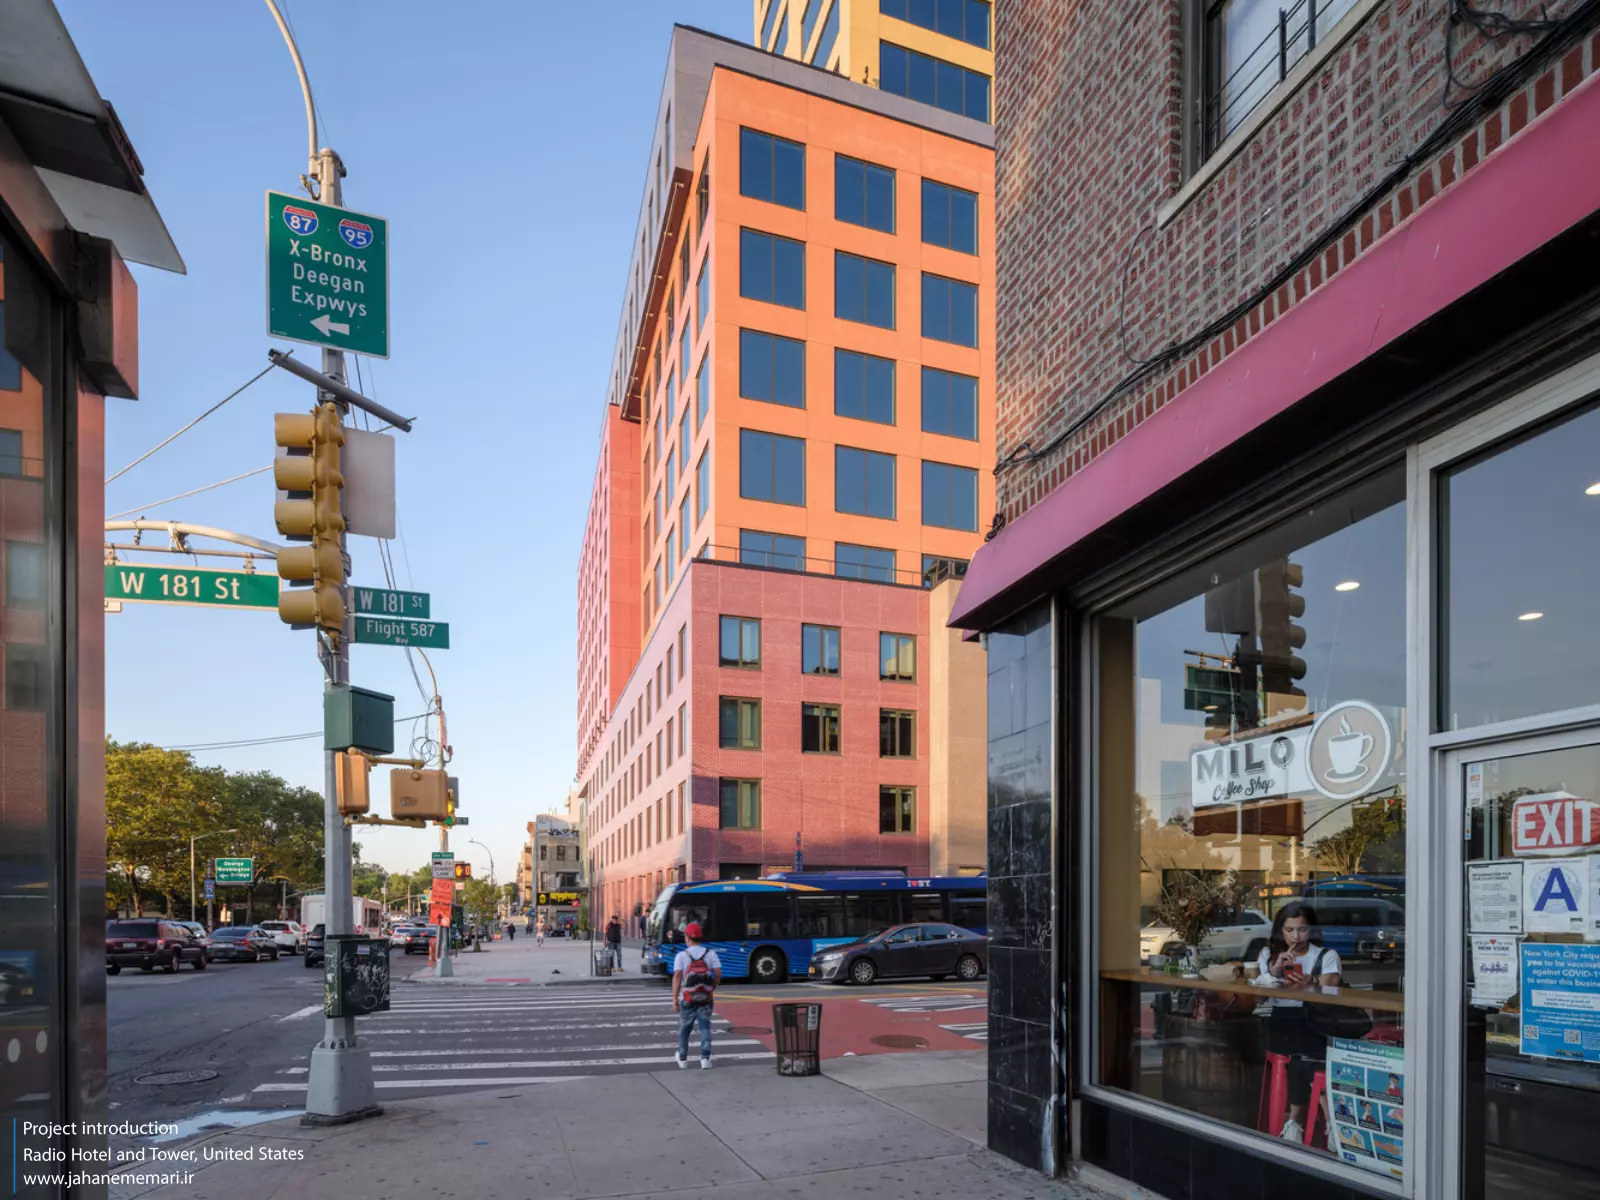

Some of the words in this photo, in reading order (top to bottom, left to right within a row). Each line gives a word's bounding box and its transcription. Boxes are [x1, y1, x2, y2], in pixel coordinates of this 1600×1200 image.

[290, 215, 312, 232] 87
[345, 229, 367, 245] 95
[289, 238, 368, 272] X-Bronx
[293, 262, 364, 294] Deegan
[292, 286, 367, 318] Expwys
[120, 572, 145, 594] W
[159, 574, 201, 598] 181
[215, 577, 240, 600] St
[360, 590, 373, 610] W
[382, 593, 404, 613] 181
[412, 596, 423, 608] St
[366, 620, 406, 638] Flight
[410, 623, 436, 637] 587
[1196, 736, 1296, 783] MILO
[1213, 781, 1244, 801] Coffee
[1244, 776, 1276, 796] Shop
[1517, 800, 1592, 848] EXIT
[1533, 867, 1578, 912] A
[1562, 951, 1578, 960] City
